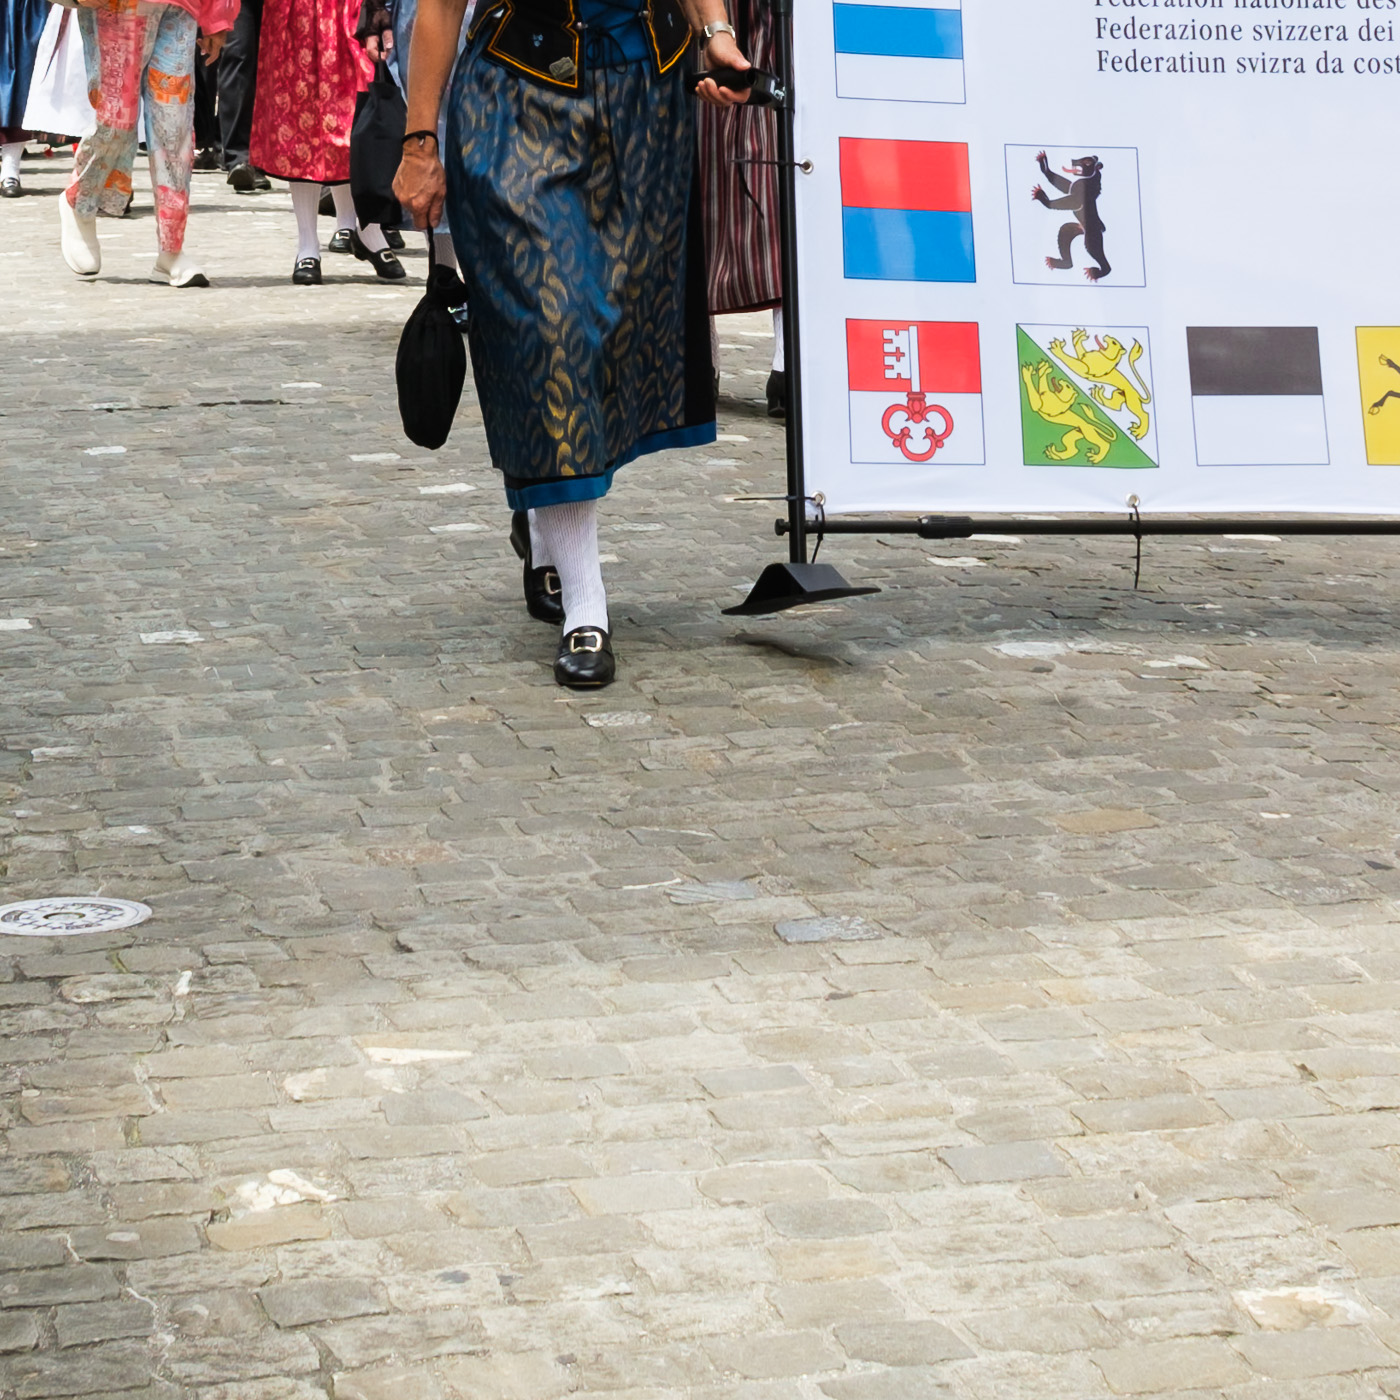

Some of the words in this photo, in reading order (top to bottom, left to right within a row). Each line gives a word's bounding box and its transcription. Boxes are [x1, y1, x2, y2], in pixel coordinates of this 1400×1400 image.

[1096, 16, 1243, 40] Federazione
[1253, 20, 1348, 41] svizzera
[1358, 18, 1394, 42] dei
[1097, 49, 1226, 73] Federatiun
[1236, 52, 1306, 74] svizra
[1316, 50, 1344, 74] da
